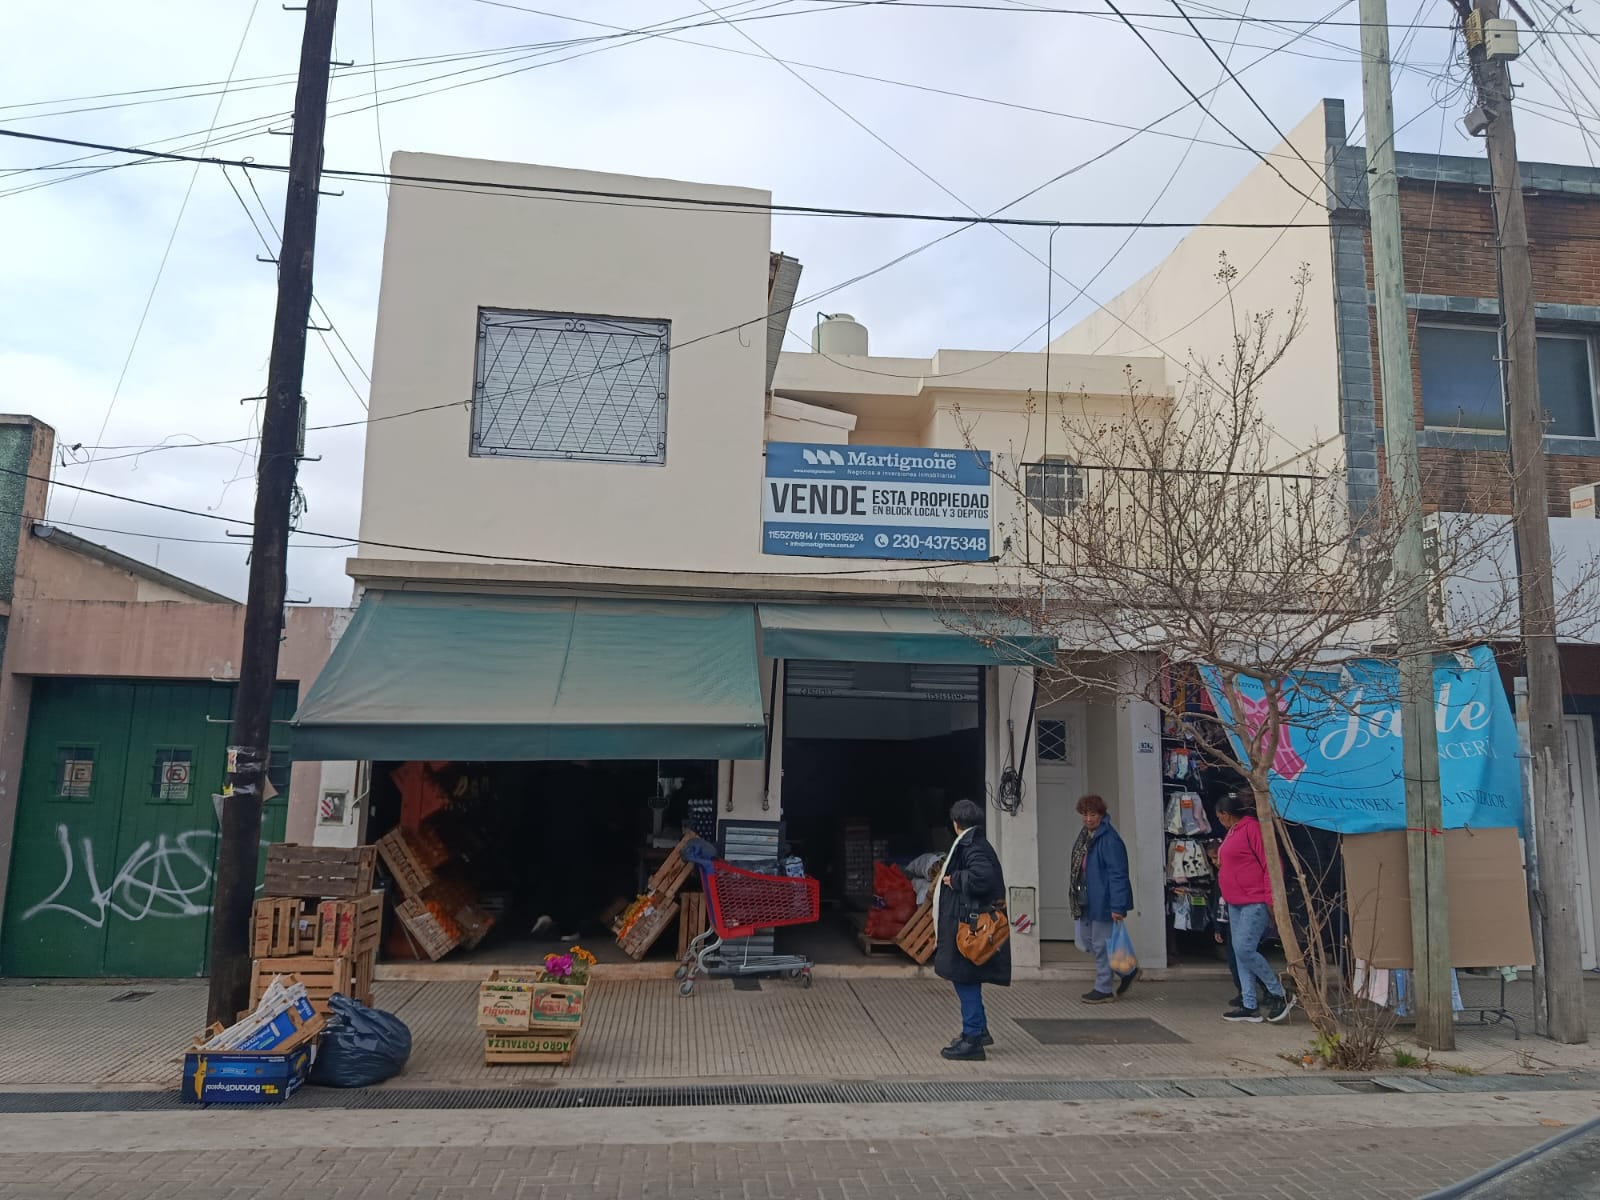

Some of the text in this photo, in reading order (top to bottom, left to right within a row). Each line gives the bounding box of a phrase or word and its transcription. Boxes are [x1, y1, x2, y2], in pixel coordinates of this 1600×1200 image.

[847, 451, 957, 471] Martignone
[847, 468, 875, 477] Negocios
[770, 482, 867, 516] VENDE
[872, 489, 989, 509] ESTA PROPIEDAD
[872, 505, 989, 519] EN BLOCK LOCAL Y 3 DEPTOS
[768, 530, 813, 540] 1155278914
[819, 532, 864, 542] 1153015924
[892, 533, 987, 551] 230-4375348
[1437, 736, 1500, 760] NCERÍ
[1338, 797, 1395, 811] UNISEX
[488, 1039, 569, 1052] AGRO FORTALEZA
[205, 1081, 261, 1094] BananaTropical
